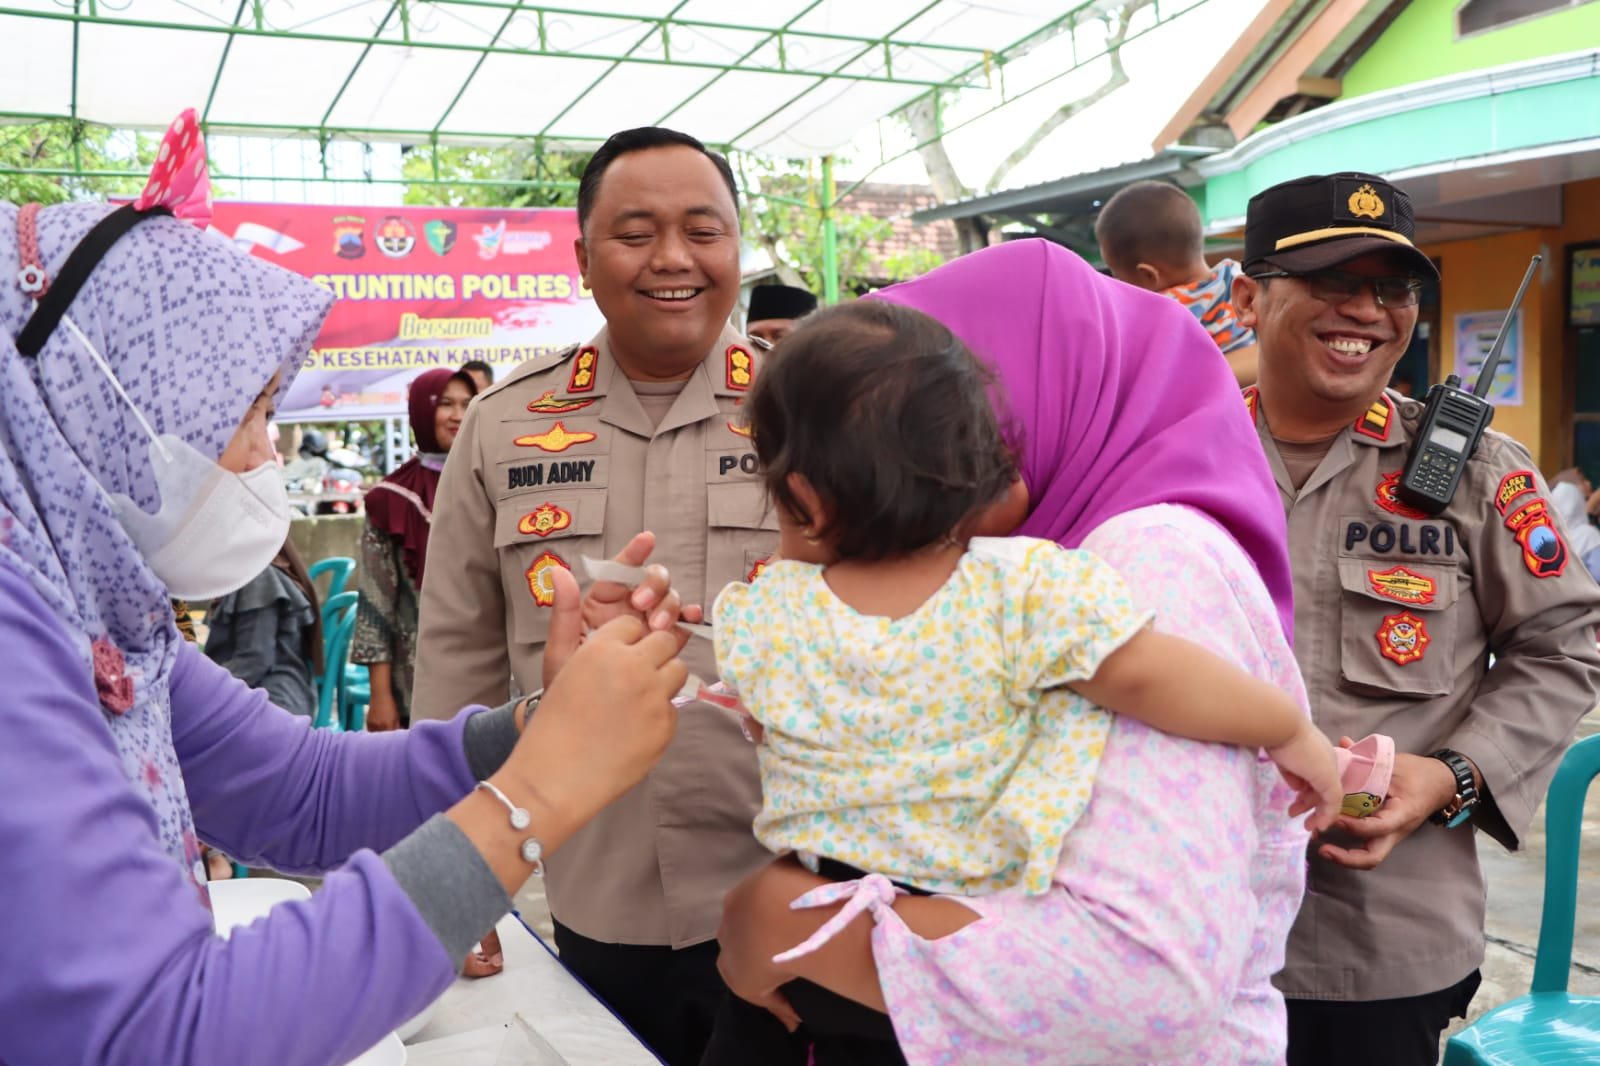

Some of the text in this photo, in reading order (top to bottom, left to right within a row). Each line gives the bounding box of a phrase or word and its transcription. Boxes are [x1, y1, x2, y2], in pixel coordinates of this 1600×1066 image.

[311, 274, 456, 300] STUNTING
[462, 274, 571, 300] POLRES
[402, 314, 491, 338] Bersama
[323, 349, 440, 368] KESEHATAN
[508, 460, 595, 489] BUDI ADHY
[1345, 522, 1454, 556] POLRI
